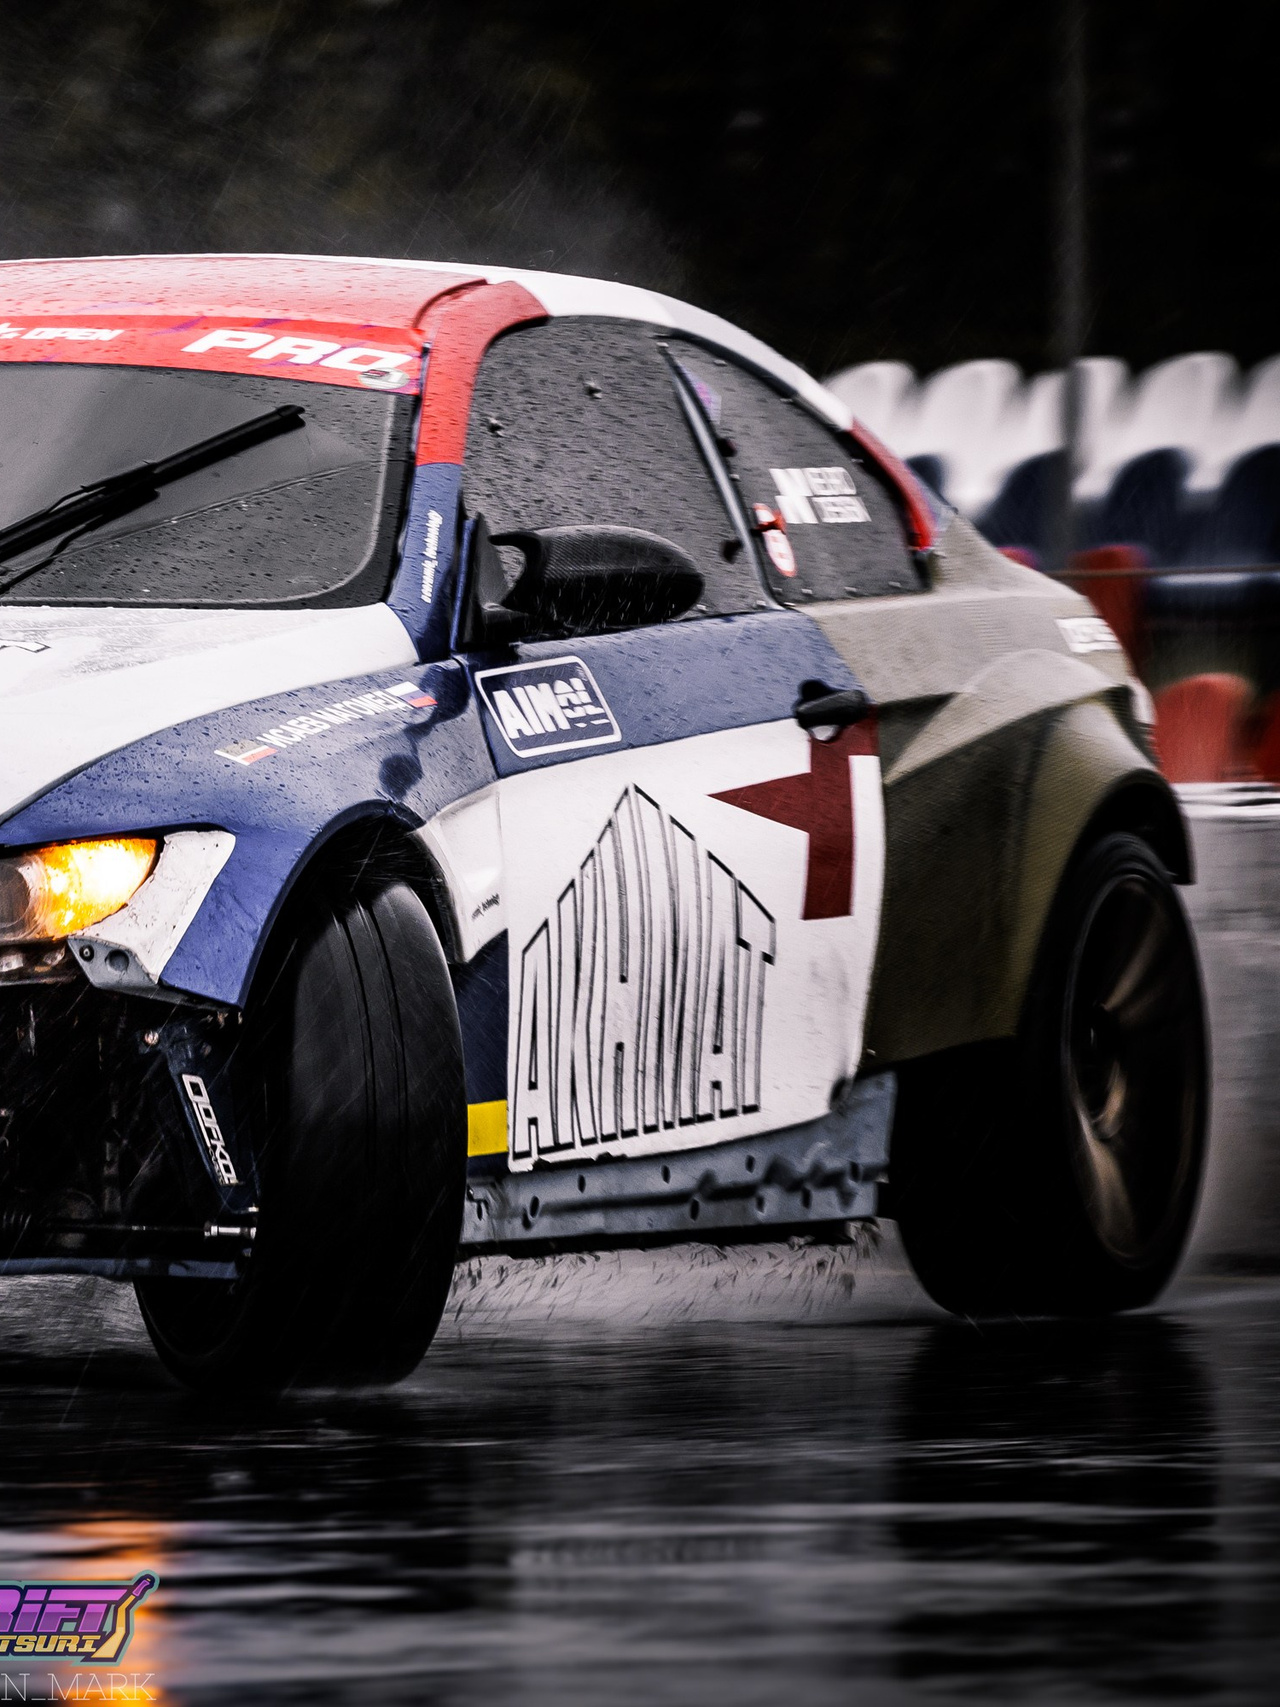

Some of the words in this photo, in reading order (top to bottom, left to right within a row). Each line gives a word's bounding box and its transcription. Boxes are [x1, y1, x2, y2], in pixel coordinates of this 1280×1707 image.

[19, 327, 125, 341] OPEN
[180, 329, 413, 372] PRO
[255, 715, 331, 748] ИСАЕВ
[512, 783, 776, 1160] AKHMAT
